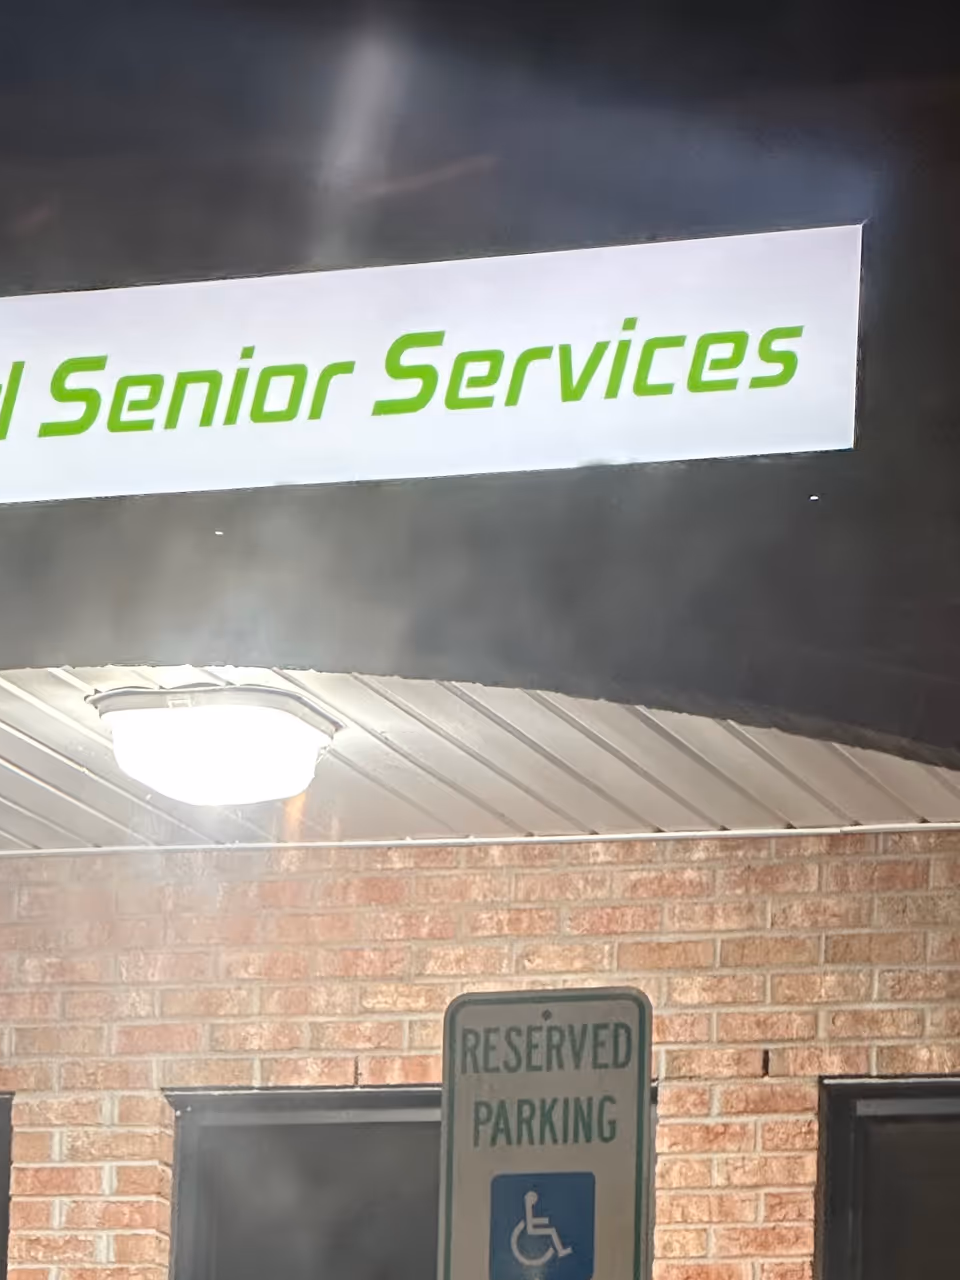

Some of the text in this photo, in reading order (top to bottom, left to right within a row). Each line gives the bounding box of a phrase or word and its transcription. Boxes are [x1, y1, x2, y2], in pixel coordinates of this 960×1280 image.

[37, 346, 355, 438] Senior
[371, 317, 803, 417] Services
[460, 1021, 633, 1075] RESERVED
[472, 1094, 617, 1148] PARKING
